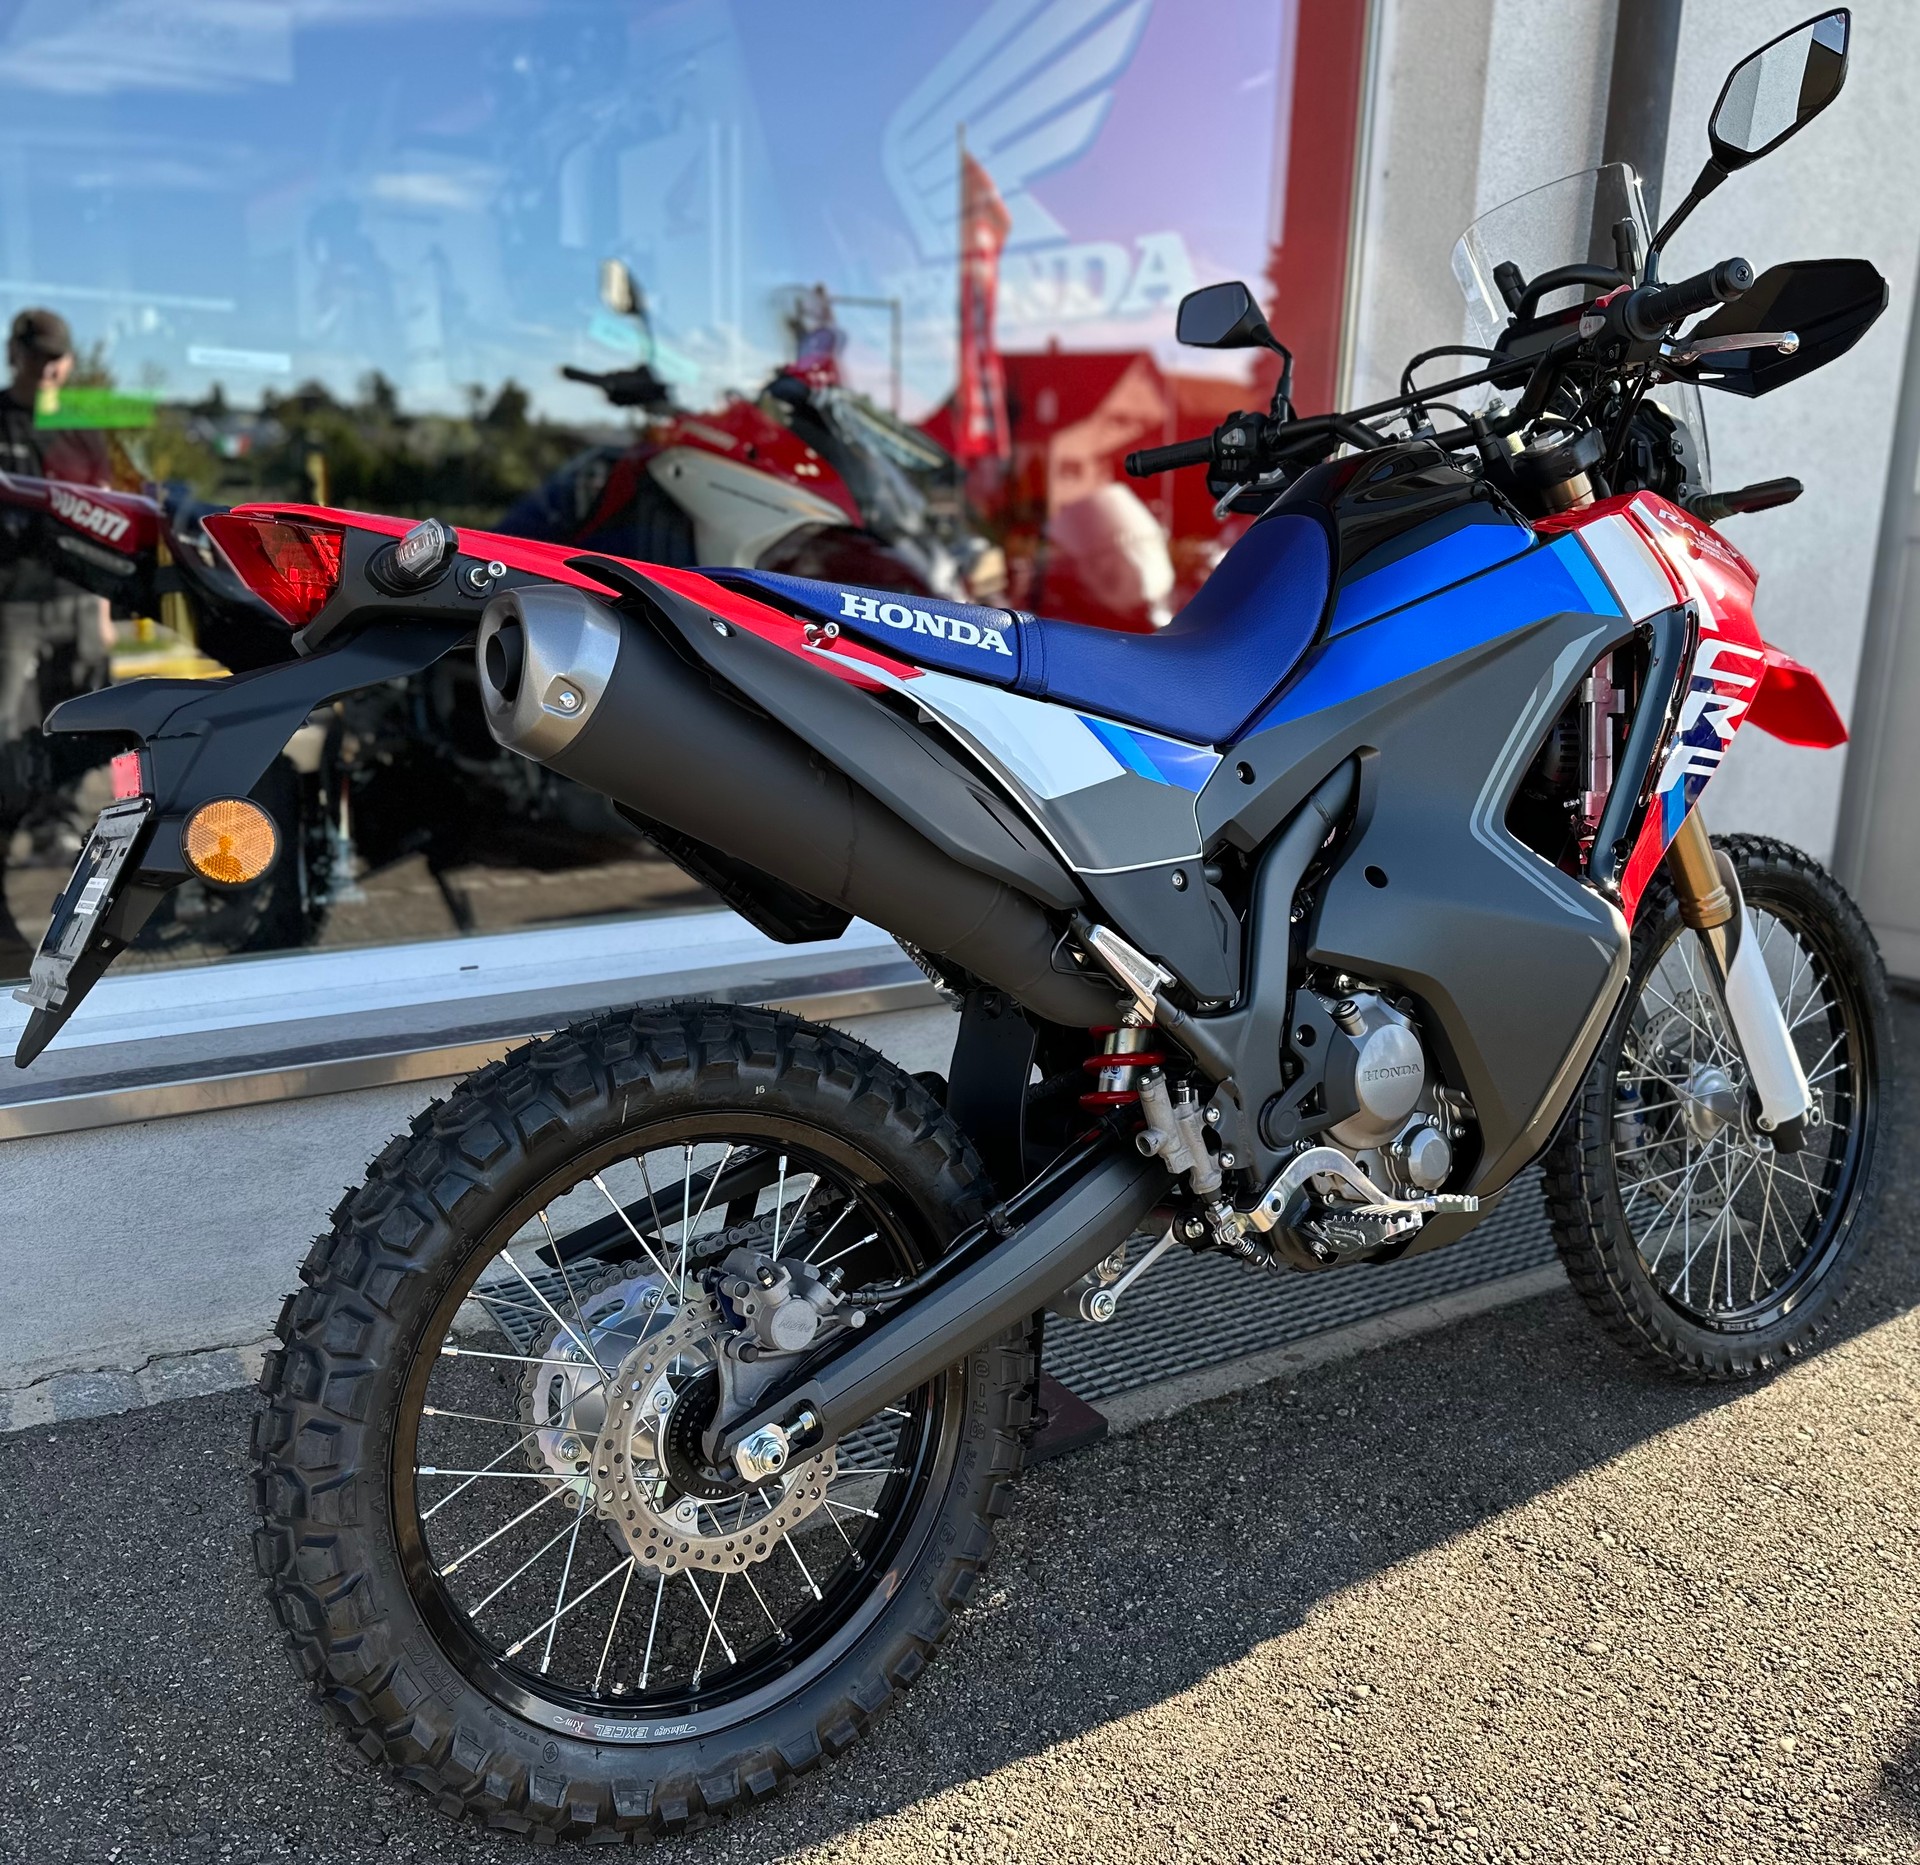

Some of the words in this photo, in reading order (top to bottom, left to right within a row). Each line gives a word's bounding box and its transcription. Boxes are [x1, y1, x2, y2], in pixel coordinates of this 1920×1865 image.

[49, 485, 130, 541] DUCATI
[1659, 509, 1740, 558] RALLY
[840, 592, 1012, 656] HONDA
[1656, 638, 1764, 794] CRF
[1364, 1064, 1421, 1081] HONDA
[917, 1520, 957, 1592] 62P
[558, 1716, 586, 1735] Rim
[594, 1723, 649, 1739] EXCEL
[654, 1723, 697, 1736] Takasago
